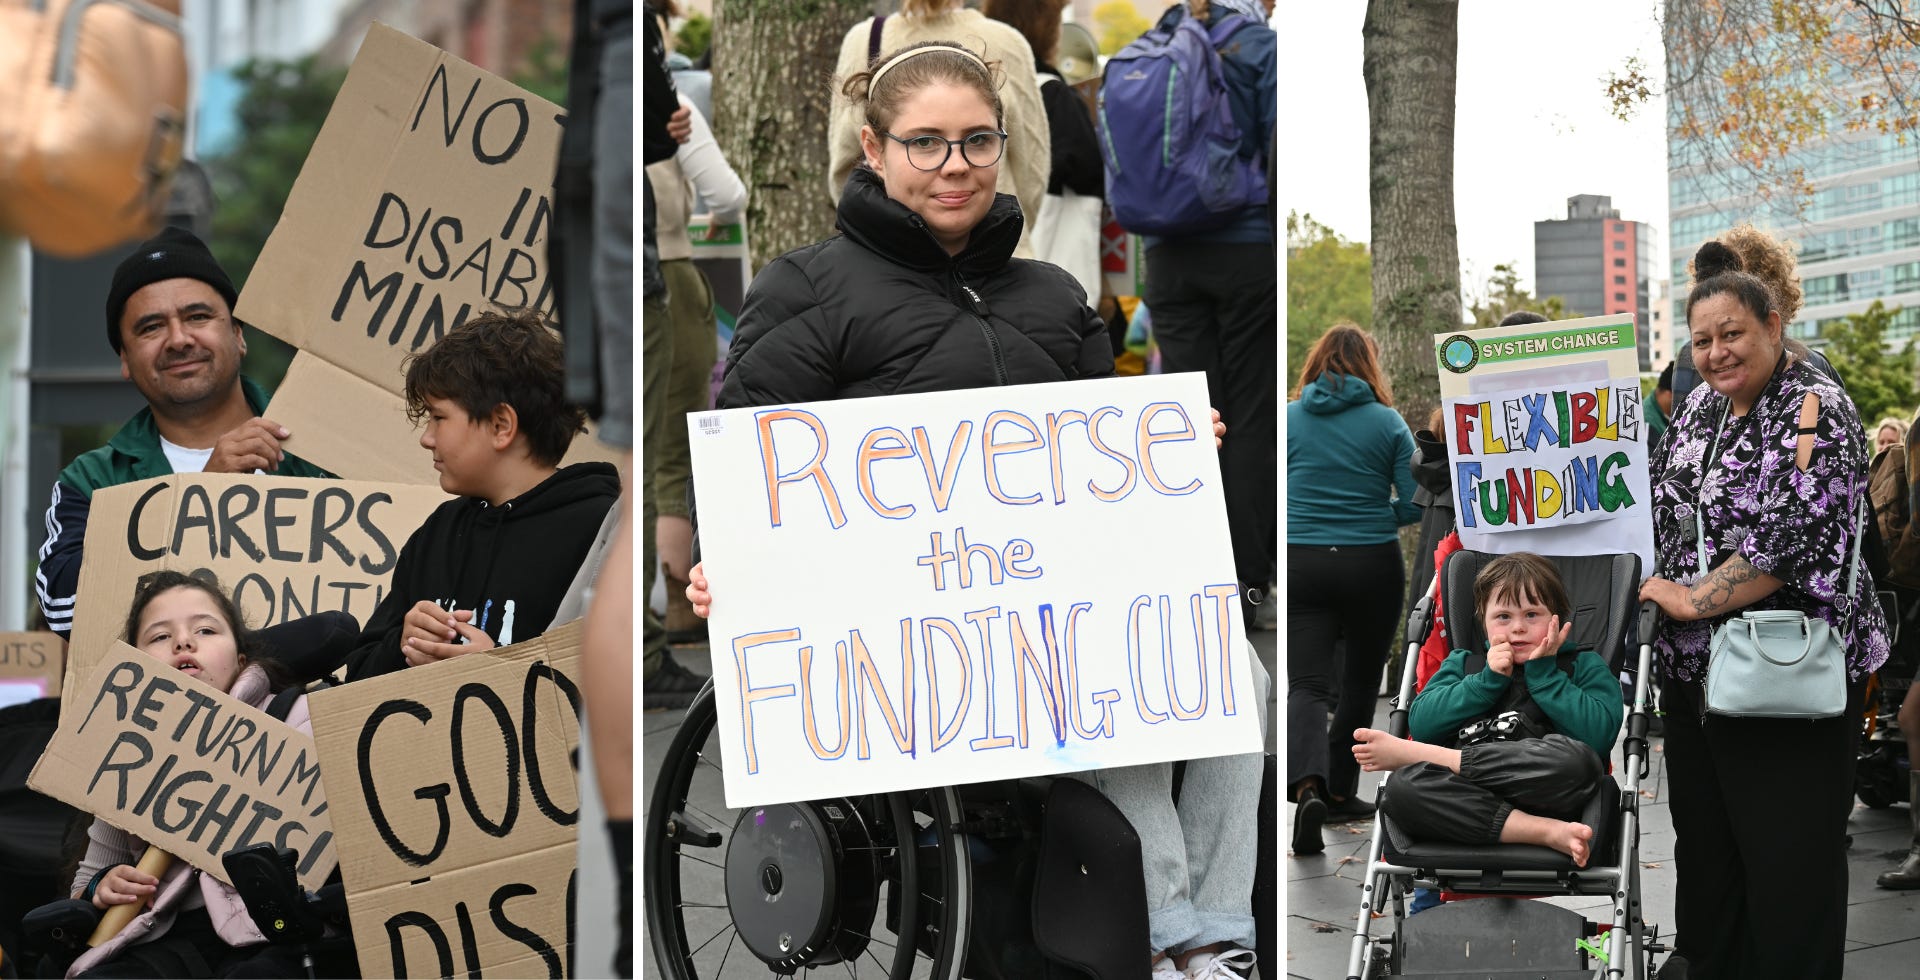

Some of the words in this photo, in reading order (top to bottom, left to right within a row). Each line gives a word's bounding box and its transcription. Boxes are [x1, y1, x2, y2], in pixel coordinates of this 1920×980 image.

[411, 64, 529, 164] NO
[1482, 338, 1548, 358] SYSTEM
[1551, 330, 1619, 350] CHANGE
[754, 402, 1203, 529] Reverse
[1454, 387, 1639, 455] FLEXIBLE
[127, 482, 397, 575] CARERS
[1456, 451, 1636, 528] FUNDING
[917, 528, 1042, 591] the
[731, 602, 1121, 775] FUNDING
[1128, 583, 1238, 723] CUT
[77, 661, 288, 786] RETURN
[276, 748, 328, 817] M
